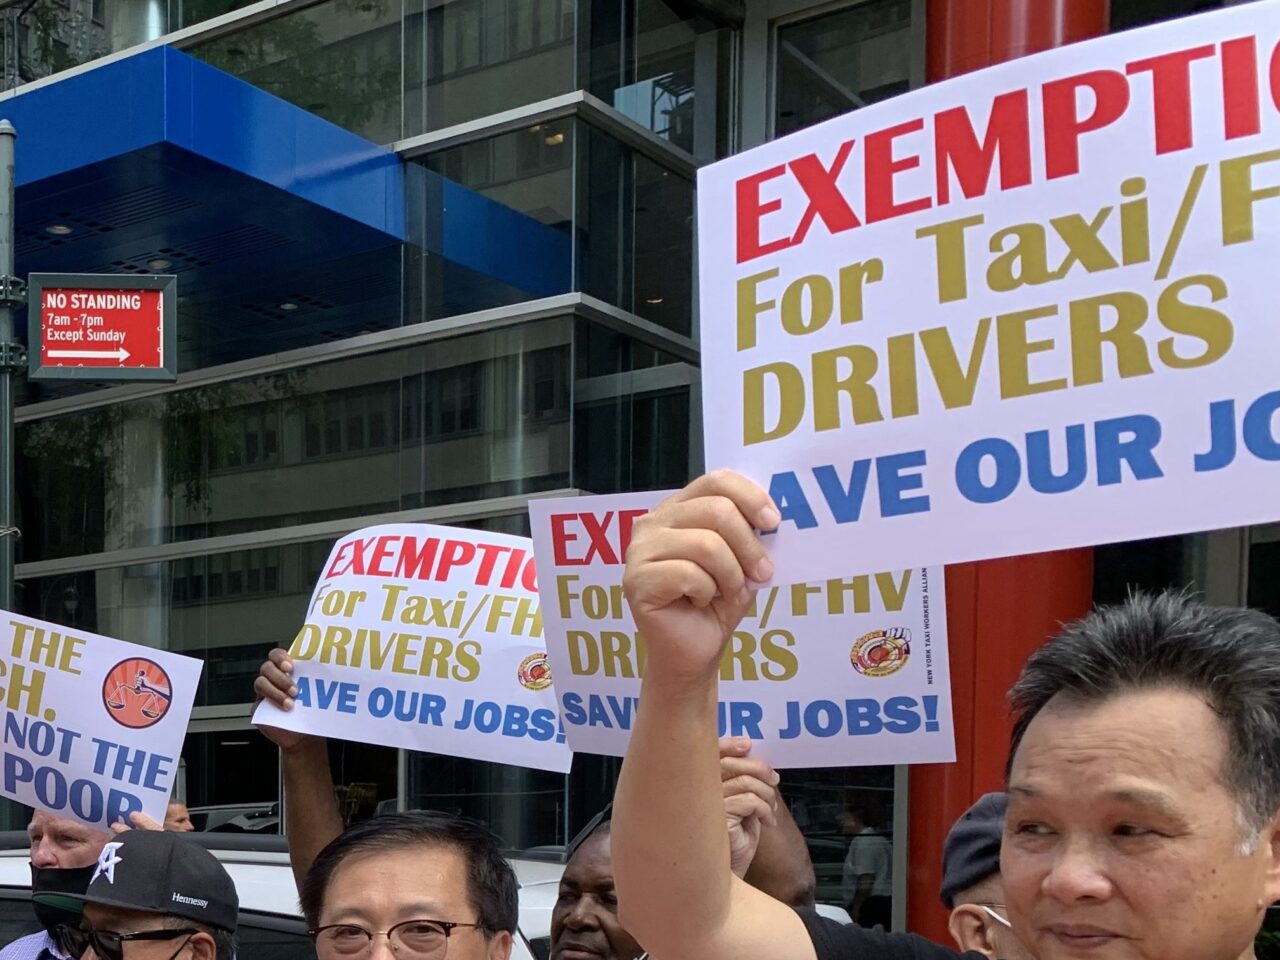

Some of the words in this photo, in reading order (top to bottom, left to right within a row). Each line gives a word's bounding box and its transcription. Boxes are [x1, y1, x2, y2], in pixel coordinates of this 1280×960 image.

[736, 34, 1280, 265] EXEMPTI
[736, 257, 884, 352] For
[916, 150, 1280, 304] Taxi/F
[47, 294, 66, 308] NO
[71, 294, 141, 310] STANDING
[47, 314, 70, 326] 7am
[80, 314, 104, 327] 7pm
[47, 328, 83, 342] Except
[86, 328, 126, 343] Sunday
[742, 274, 1234, 446] DRIVERS
[760, 450, 931, 535] AVE
[954, 414, 1164, 504] OUR
[325, 535, 540, 592] EXEMPTI
[310, 584, 366, 618] For
[382, 584, 544, 638] Taxi/FH
[10, 620, 87, 676] THE
[288, 624, 482, 682] DRIVERS
[566, 629, 798, 681] DRIRS
[294, 677, 359, 714] AVE
[368, 687, 447, 726] OUR
[455, 699, 566, 744] JOBS!
[564, 692, 640, 730] SAV
[780, 695, 940, 740] JOBS!
[4, 712, 80, 764] NOT
[92, 737, 172, 792] THE
[172, 892, 208, 908] Hennessy
